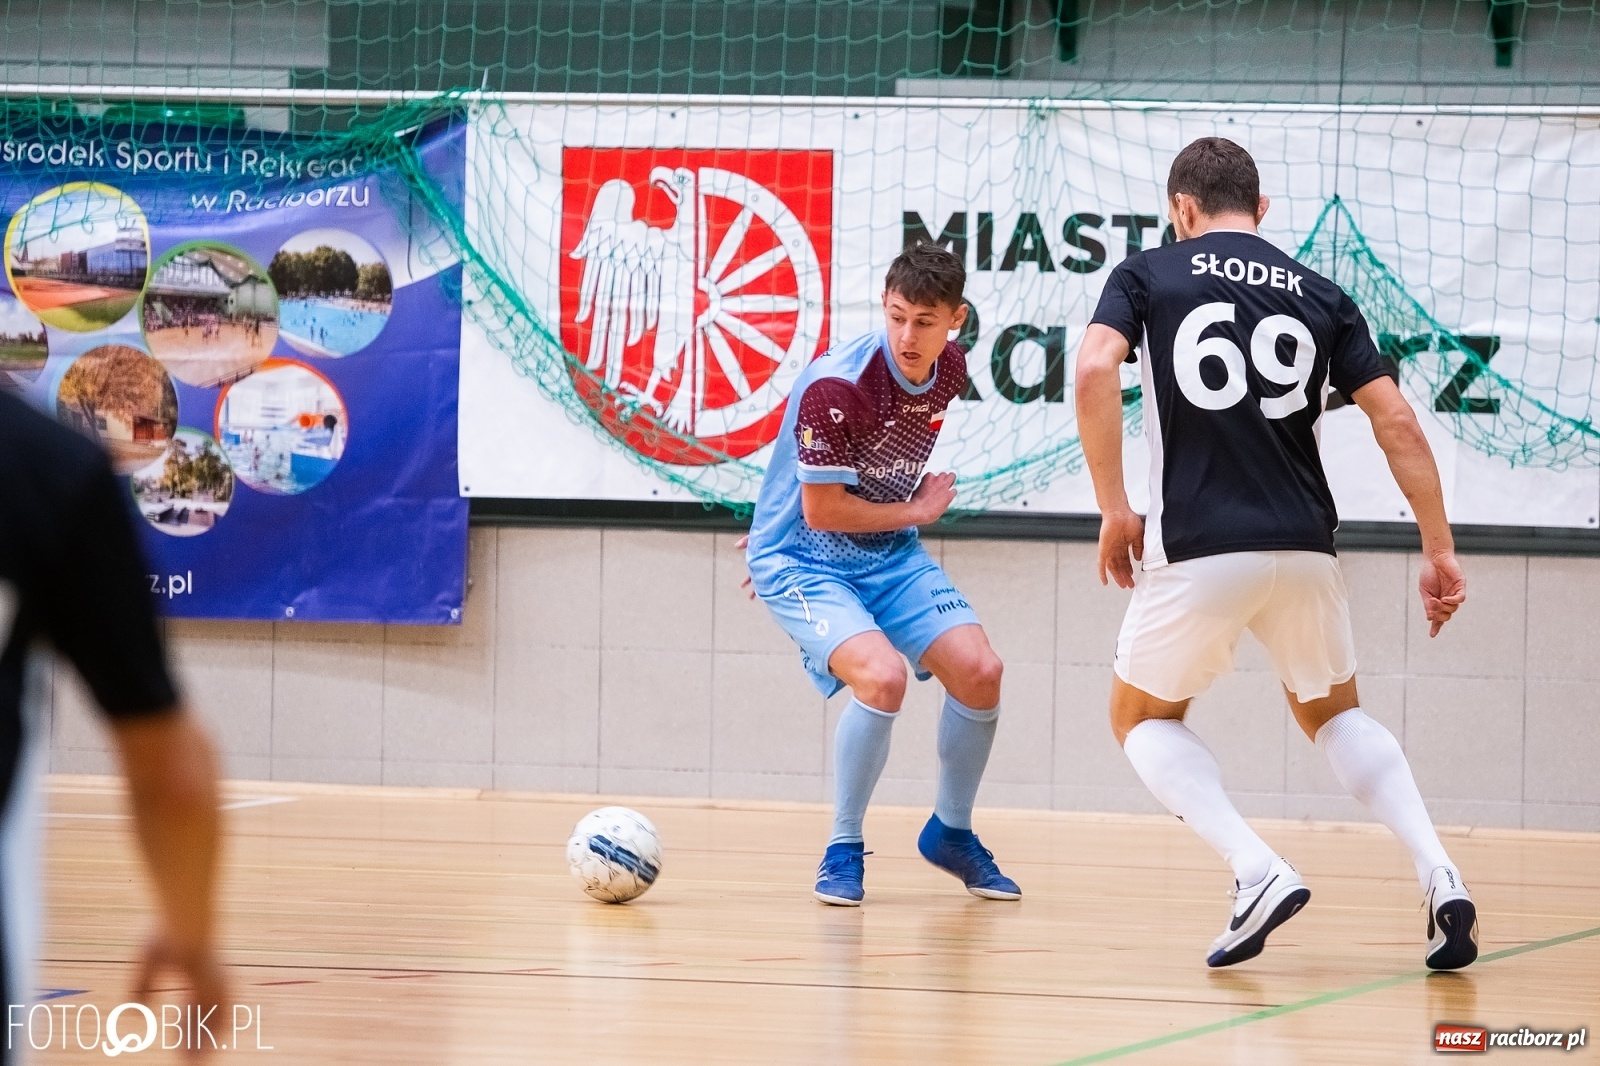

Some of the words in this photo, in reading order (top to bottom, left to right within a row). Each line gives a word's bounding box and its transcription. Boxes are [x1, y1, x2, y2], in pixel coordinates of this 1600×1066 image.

[0, 134, 104, 167] środek
[116, 142, 211, 175] Sportu
[223, 149, 229, 175] i
[191, 194, 213, 213] w
[903, 211, 1177, 274] MIAST
[1191, 253, 1303, 297] SŁODEK
[1173, 302, 1317, 419] 69
[145, 569, 193, 600] z.pl
[935, 599, 970, 615] Int-D
